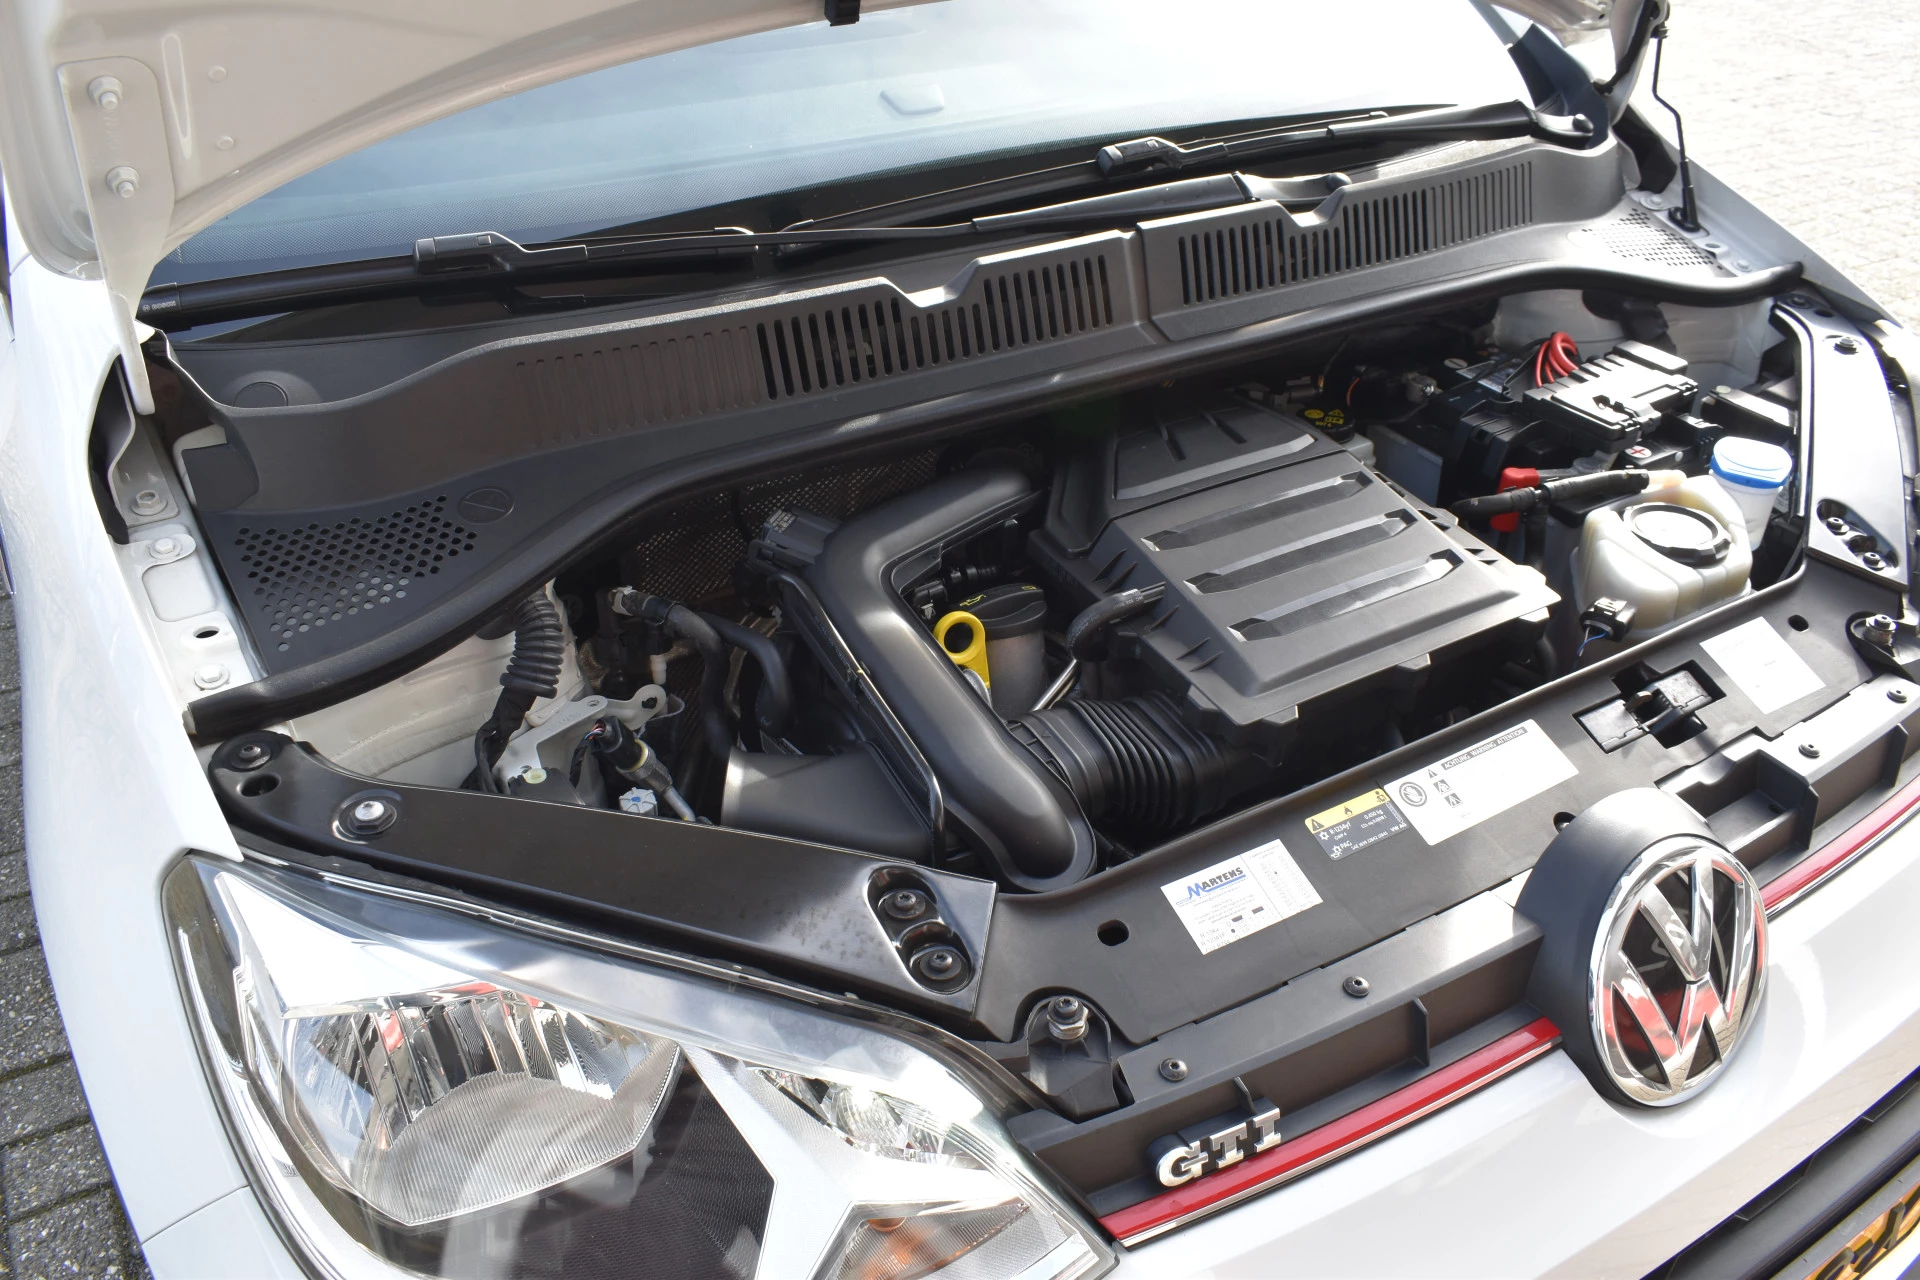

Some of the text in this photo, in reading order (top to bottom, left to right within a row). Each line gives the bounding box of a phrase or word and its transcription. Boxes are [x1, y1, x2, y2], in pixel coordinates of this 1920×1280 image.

[152, 300, 177, 309] BOSCH
[1444, 728, 1525, 768] ACHTUNG WARNING ATTENTION
[1340, 840, 1352, 849] PAG
[1187, 867, 1244, 899] MARTENS
[1156, 1107, 1282, 1188] GTI
